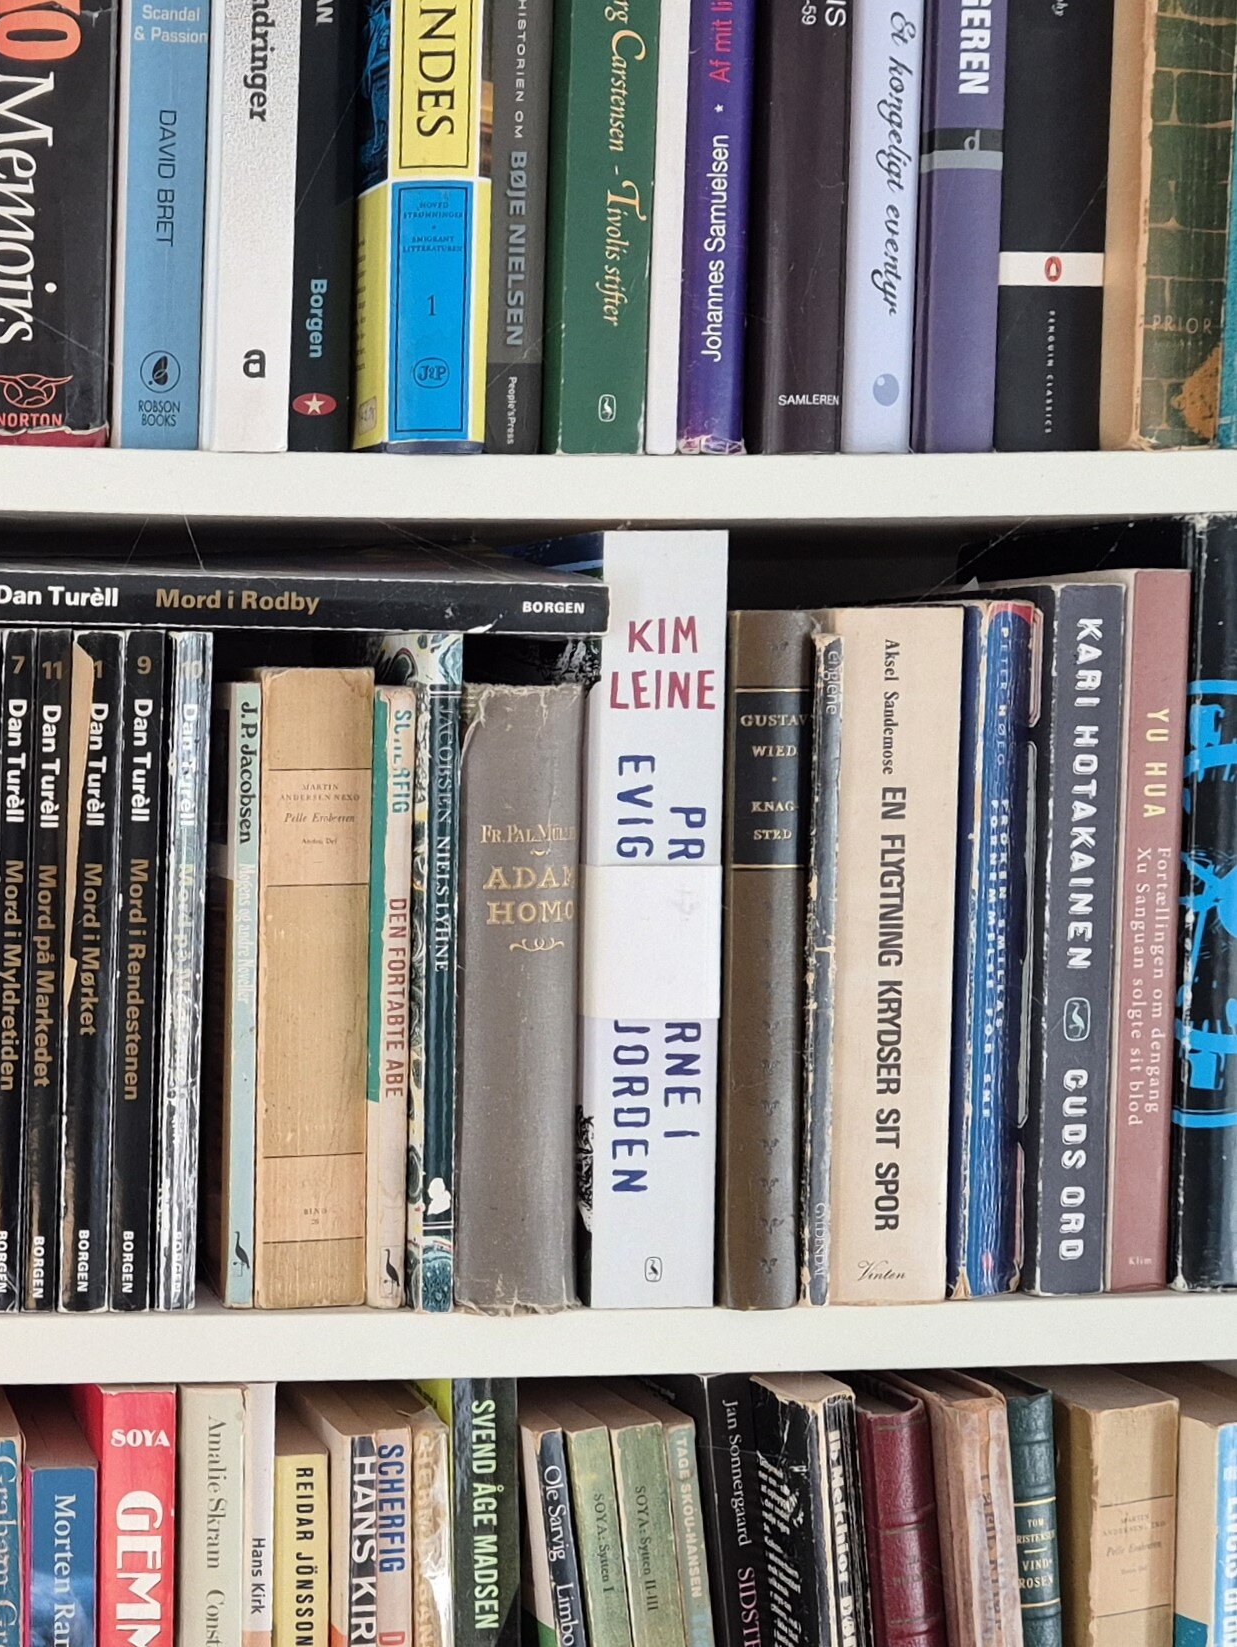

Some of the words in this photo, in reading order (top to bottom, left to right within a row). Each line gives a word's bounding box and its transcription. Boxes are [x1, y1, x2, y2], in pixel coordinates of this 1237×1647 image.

[143, 5, 200, 21] Scandal
[608, 30, 646, 152] Carstensen
[157, 109, 177, 178] DAVID
[514, 111, 525, 139] OM
[876, 56, 914, 204] kongeligt
[506, 152, 527, 216] BØJE
[704, 135, 729, 252] Samuelsen
[156, 189, 175, 248] BRET
[506, 225, 526, 346] NIELSEN
[872, 204, 900, 317] eventyr
[305, 278, 328, 358] Borgen
[427, 295, 436, 316] 1
[702, 260, 725, 362] Johannes
[1047, 310, 1056, 366] PENGUIN
[138, 400, 180, 413] ROBSON
[141, 414, 176, 427] BOOKS
[778, 394, 839, 406] SAMLEREN
[1044, 374, 1054, 434] CLASSICS
[156, 588, 221, 610] Mord
[522, 602, 585, 614] BORGEN
[628, 616, 698, 654] KIM
[1074, 618, 1104, 707] KARI
[12, 656, 25, 674] 7
[137, 656, 151, 674] 9
[610, 670, 715, 709] LEINE
[740, 714, 809, 727] GUSTAV
[1146, 708, 1170, 743] YU
[751, 745, 797, 757] WIED
[239, 743, 257, 844] Jacobsen
[285, 813, 306, 823] Pelle
[616, 754, 655, 859] EVIG
[1143, 762, 1167, 818] HUA
[753, 829, 791, 840] STED
[1066, 725, 1100, 969] HOTAKAINEN
[1137, 848, 1151, 874] Xu
[876, 834, 906, 968] FLYGTNING
[386, 947, 406, 1053] FORTABTE
[1151, 989, 1162, 1019] om
[875, 980, 903, 1095] KRYDSER
[1132, 1045, 1141, 1073] sit
[874, 1108, 901, 1149] SIT
[1061, 1068, 1088, 1170] GUDS
[874, 1162, 900, 1231] SPOR
[1059, 1186, 1086, 1260] ORD
[33, 1236, 44, 1298] BORGEN
[78, 1229, 89, 1292] BORGEN
[122, 1231, 134, 1293] BORGEN
[1129, 1257, 1152, 1265] Klim
[111, 1429, 170, 1447] SOYA
[472, 1399, 496, 1475] SVEND
[295, 1467, 313, 1541] REIDAR
[351, 1456, 377, 1563] HANS
[378, 1444, 405, 1573] SCHERFIG
[472, 1482, 504, 1528] ÅGE
[544, 1465, 562, 1501] Ole
[54, 1494, 76, 1595] Morten
[207, 1498, 227, 1569] Skram
[252, 1538, 266, 1577] Hans
[252, 1583, 266, 1615] Kirk
[474, 1535, 499, 1630] MADSEN
